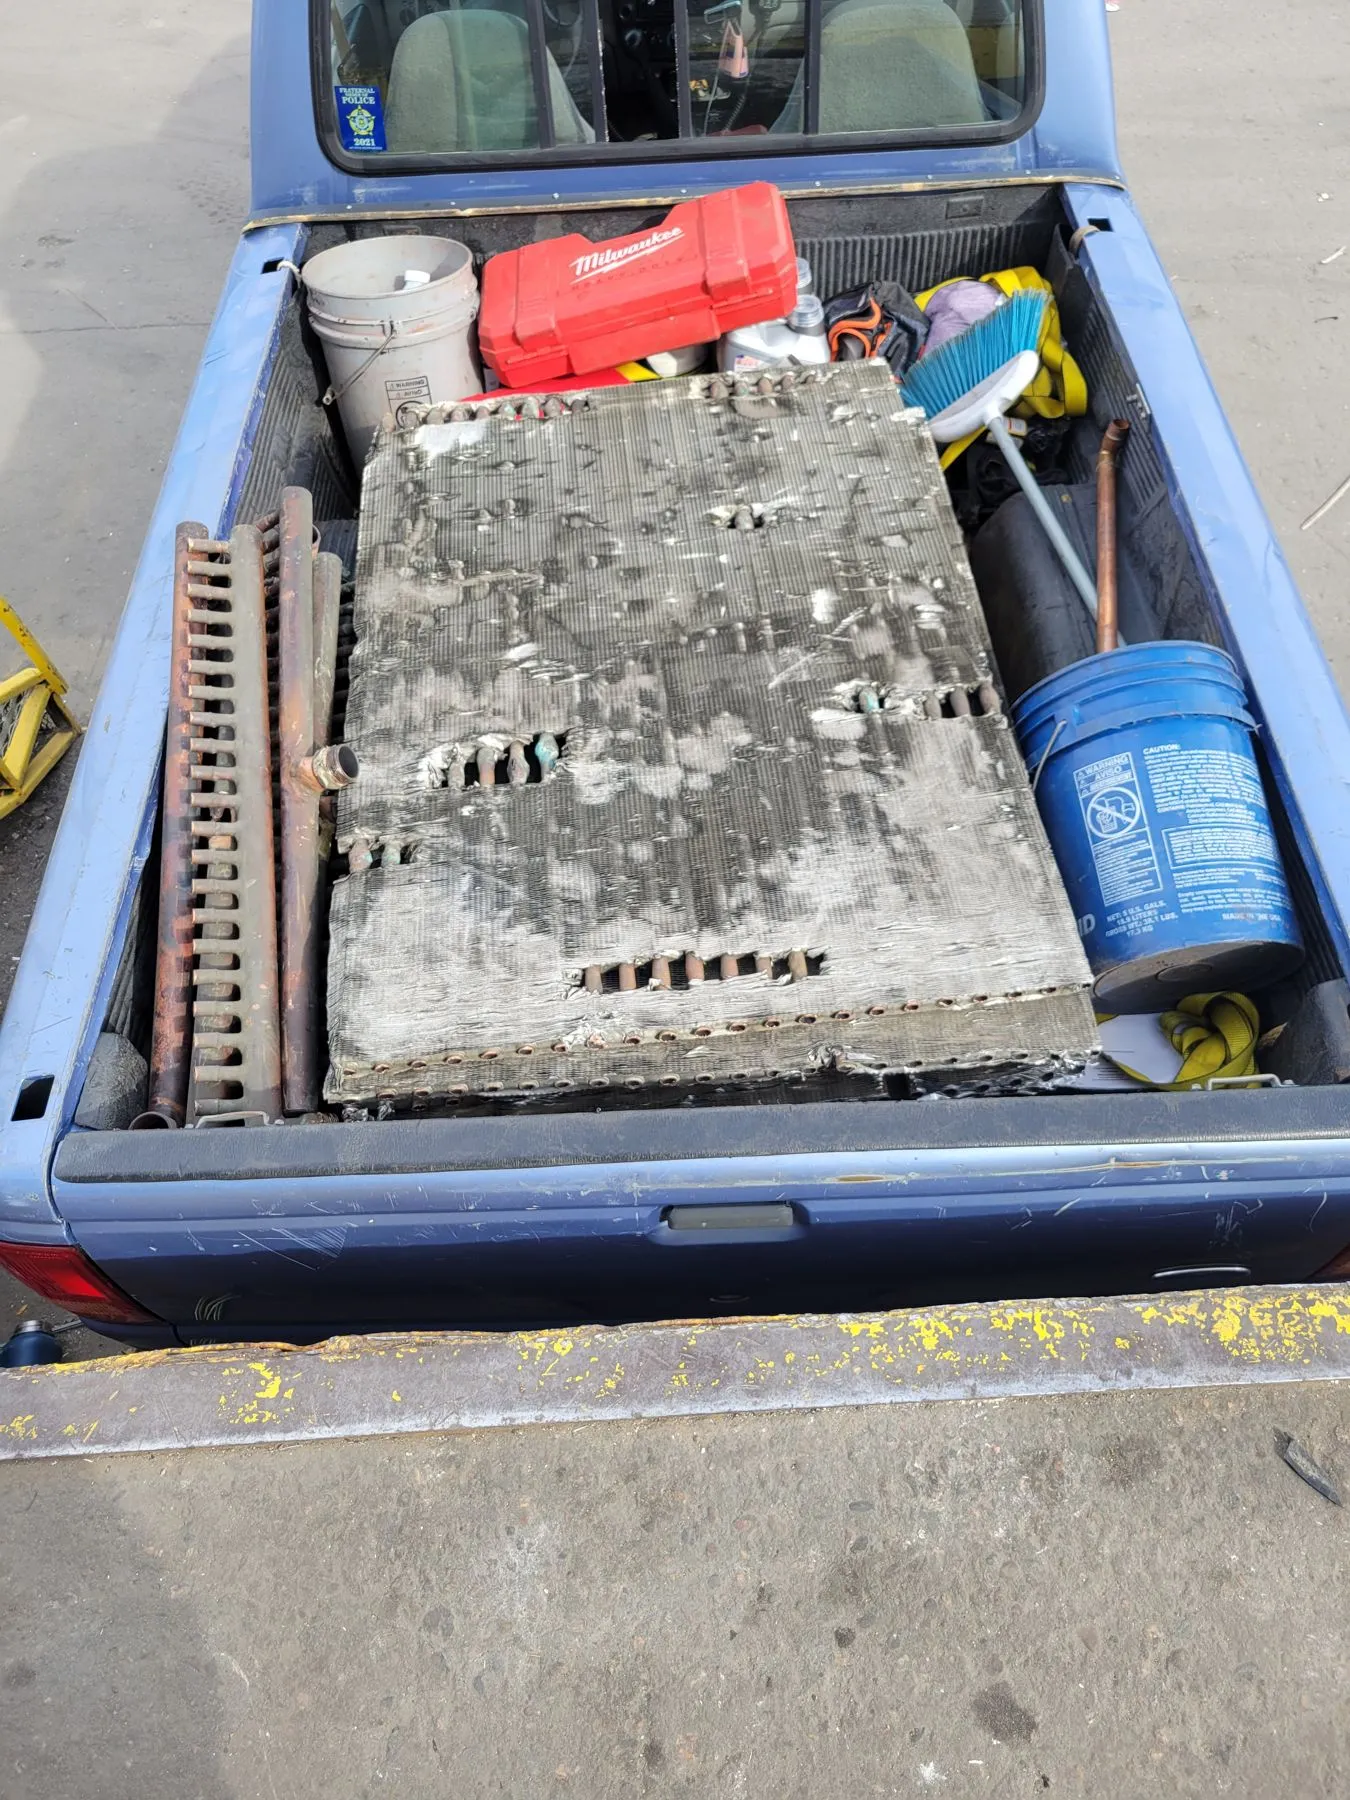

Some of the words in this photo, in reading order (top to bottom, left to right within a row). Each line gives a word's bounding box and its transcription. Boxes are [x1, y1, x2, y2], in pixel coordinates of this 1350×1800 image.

[342, 96, 375, 105] POLICE
[354, 138, 376, 147] 2021
[568, 227, 684, 277] Milwaukee
[1143, 743, 1181, 755] CAUTION:
[1086, 754, 1129, 776] WARNING
[1095, 765, 1122, 783] AVISO
